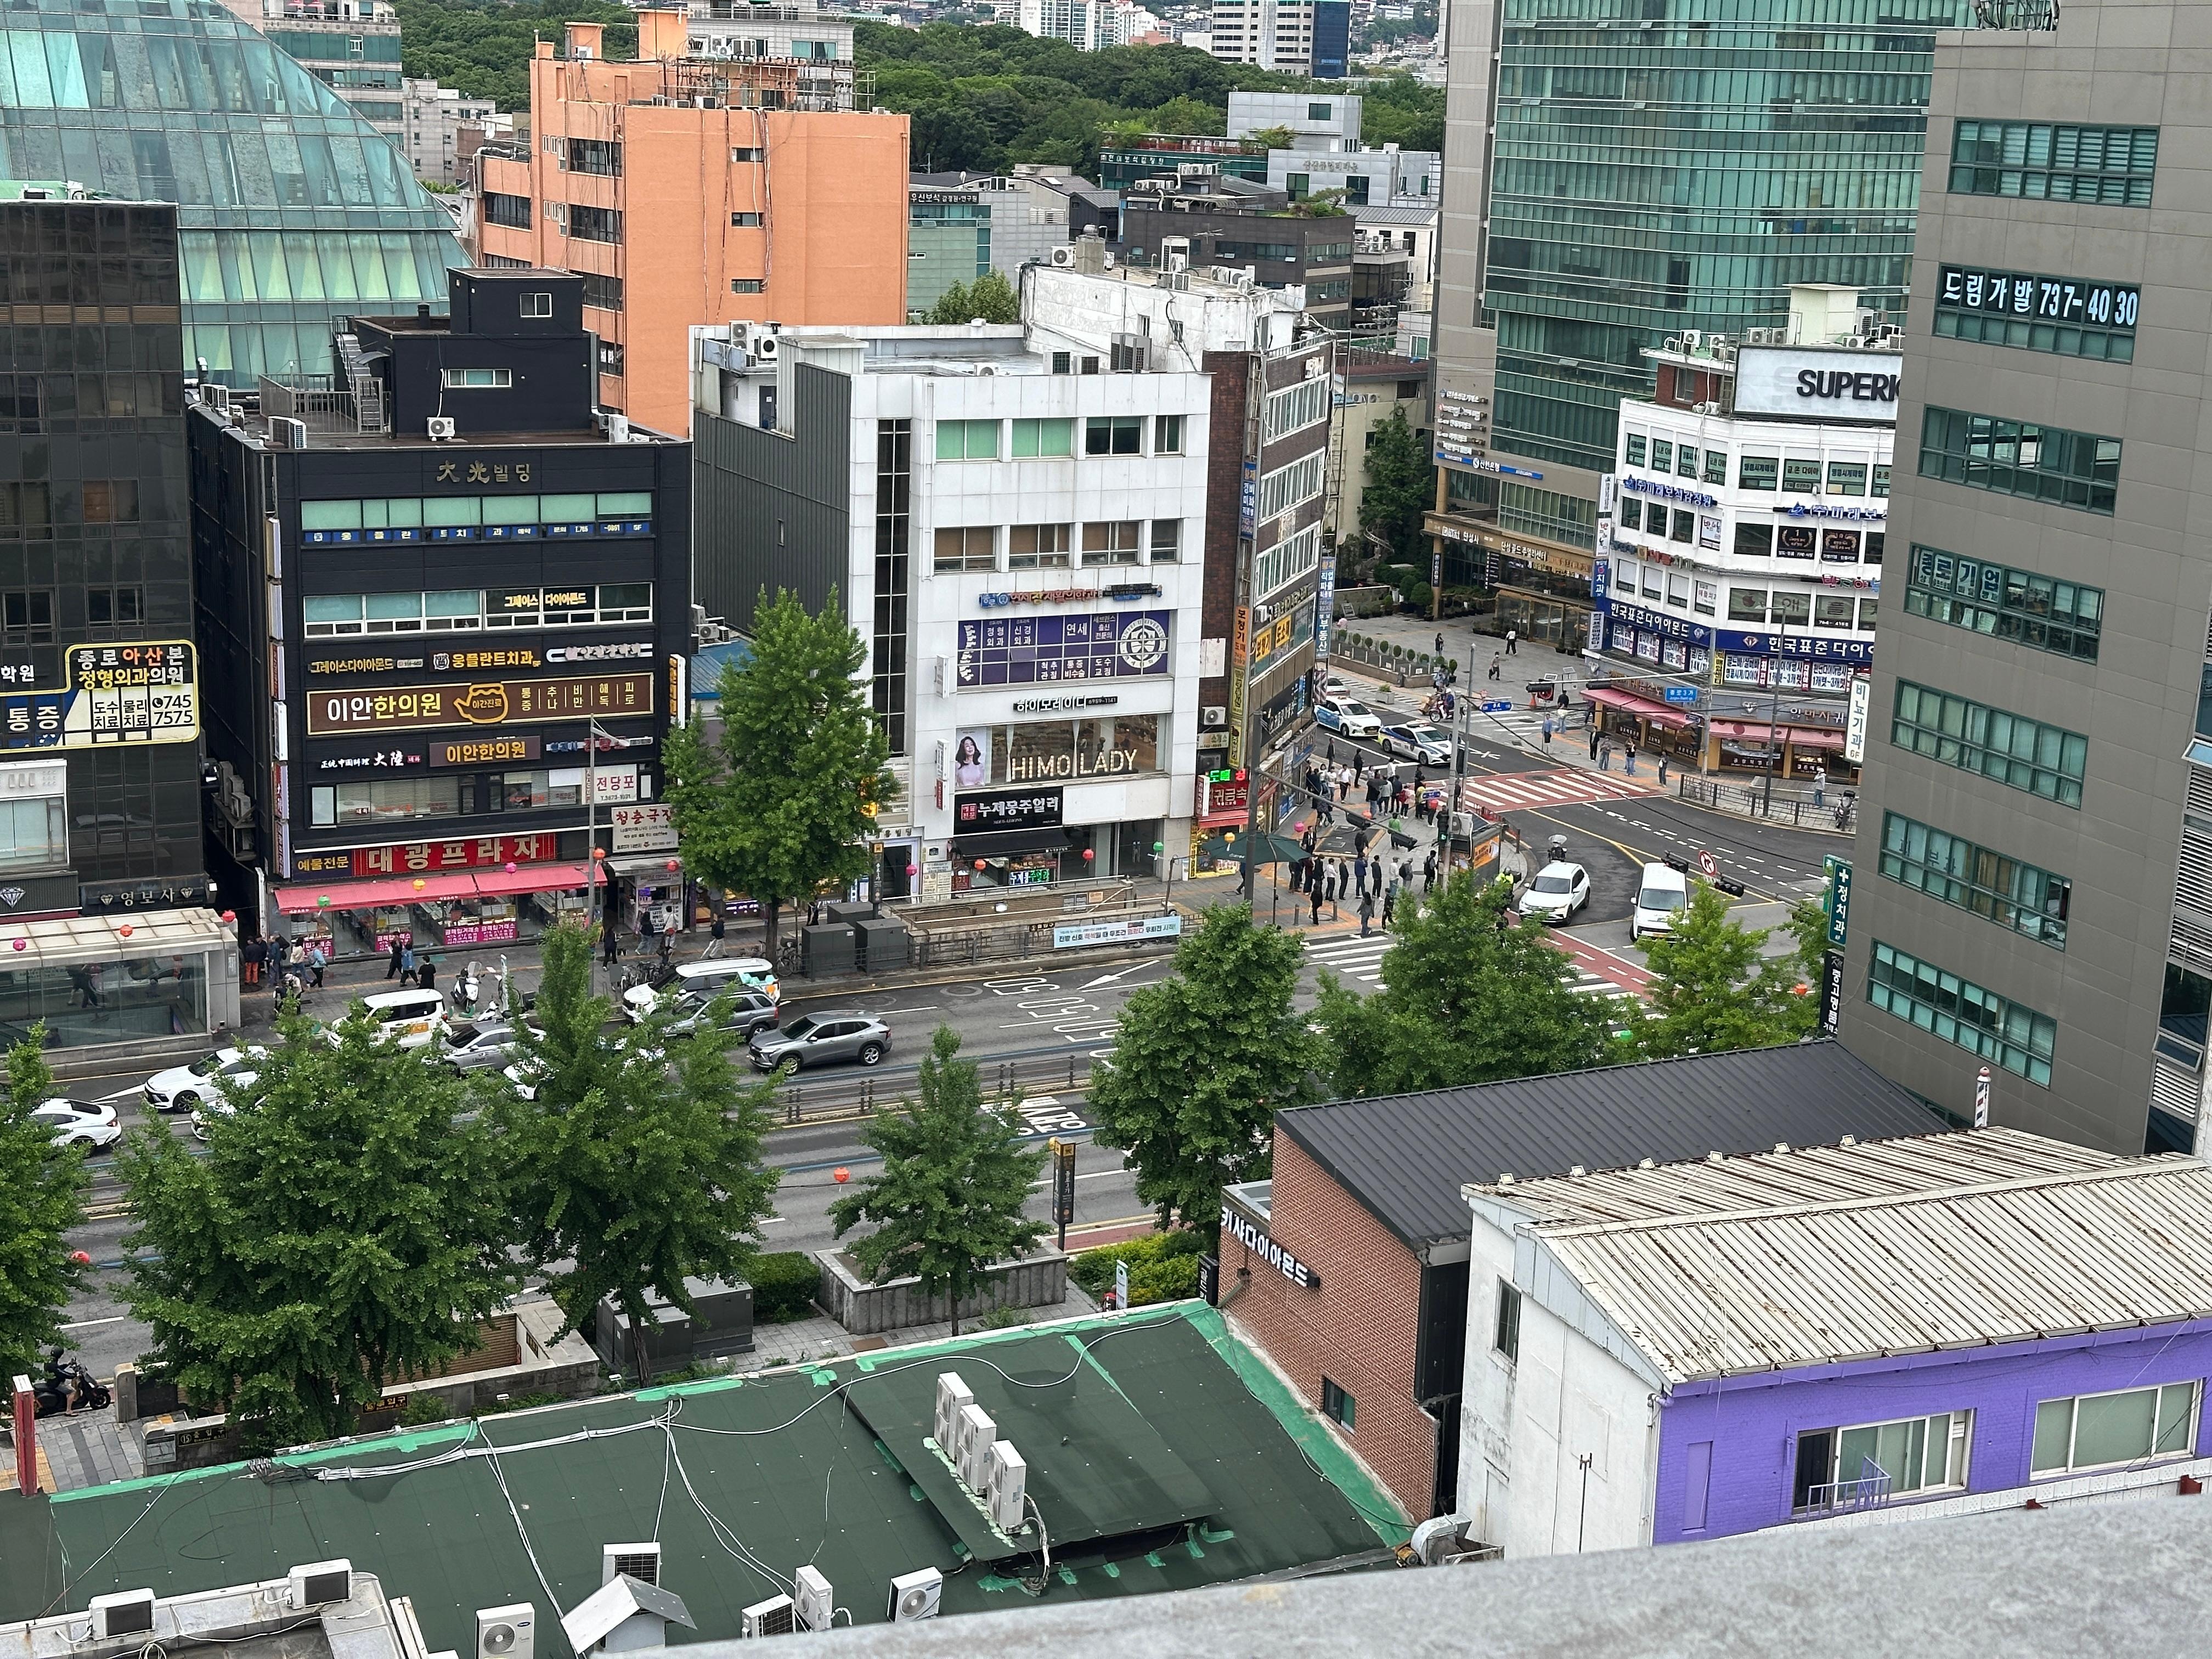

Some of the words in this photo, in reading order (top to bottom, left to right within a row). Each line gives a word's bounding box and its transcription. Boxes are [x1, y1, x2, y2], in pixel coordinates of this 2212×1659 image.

[1943, 272, 2033, 313] 드림가발
[1797, 369, 1900, 401] SUPERI
[1810, 504, 1888, 521] (주)미래보
[1237, 609, 1246, 642] 보청기
[1611, 603, 1689, 637] 한국표준다이아몬드
[1014, 625, 1031, 635] 신경
[1066, 623, 1088, 636] 연세
[1014, 635, 1031, 646] 외과
[77, 646, 185, 670] 종로아산본
[310, 657, 394, 674] 그레이스다이아몬드
[1, 665, 35, 683] 학원
[78, 667, 184, 690] 정형외과의원
[1064, 669, 1085, 679] 비수술
[123, 699, 148, 714] 물리
[163, 695, 192, 709] 745
[472, 698, 502, 710] 야간진료
[521, 687, 532, 711] 통증
[547, 686, 557, 709] 추나
[573, 684, 583, 708] 비만
[1017, 695, 1086, 713] 하이모레이디
[94, 700, 119, 714] 도수
[328, 693, 441, 722] 이안한의원
[7, 705, 60, 732] 통증
[94, 715, 119, 729] 치료
[123, 714, 149, 729] 치료
[155, 710, 193, 725] 7575
[1852, 684, 1867, 750] 비뇨기과
[446, 741, 527, 763] 이안한의원
[1850, 750, 1860, 760] 6F
[1011, 755, 1070, 781] HIMO
[1079, 748, 1138, 775] LADY
[596, 775, 634, 792] 전당포
[368, 834, 540, 873] 대광프라자
[297, 856, 349, 872] 예물전문
[120, 887, 176, 907] 영보사
[1833, 884, 1848, 935] 정치과
[1221, 1206, 1308, 1287] 키샤다이아몬드
